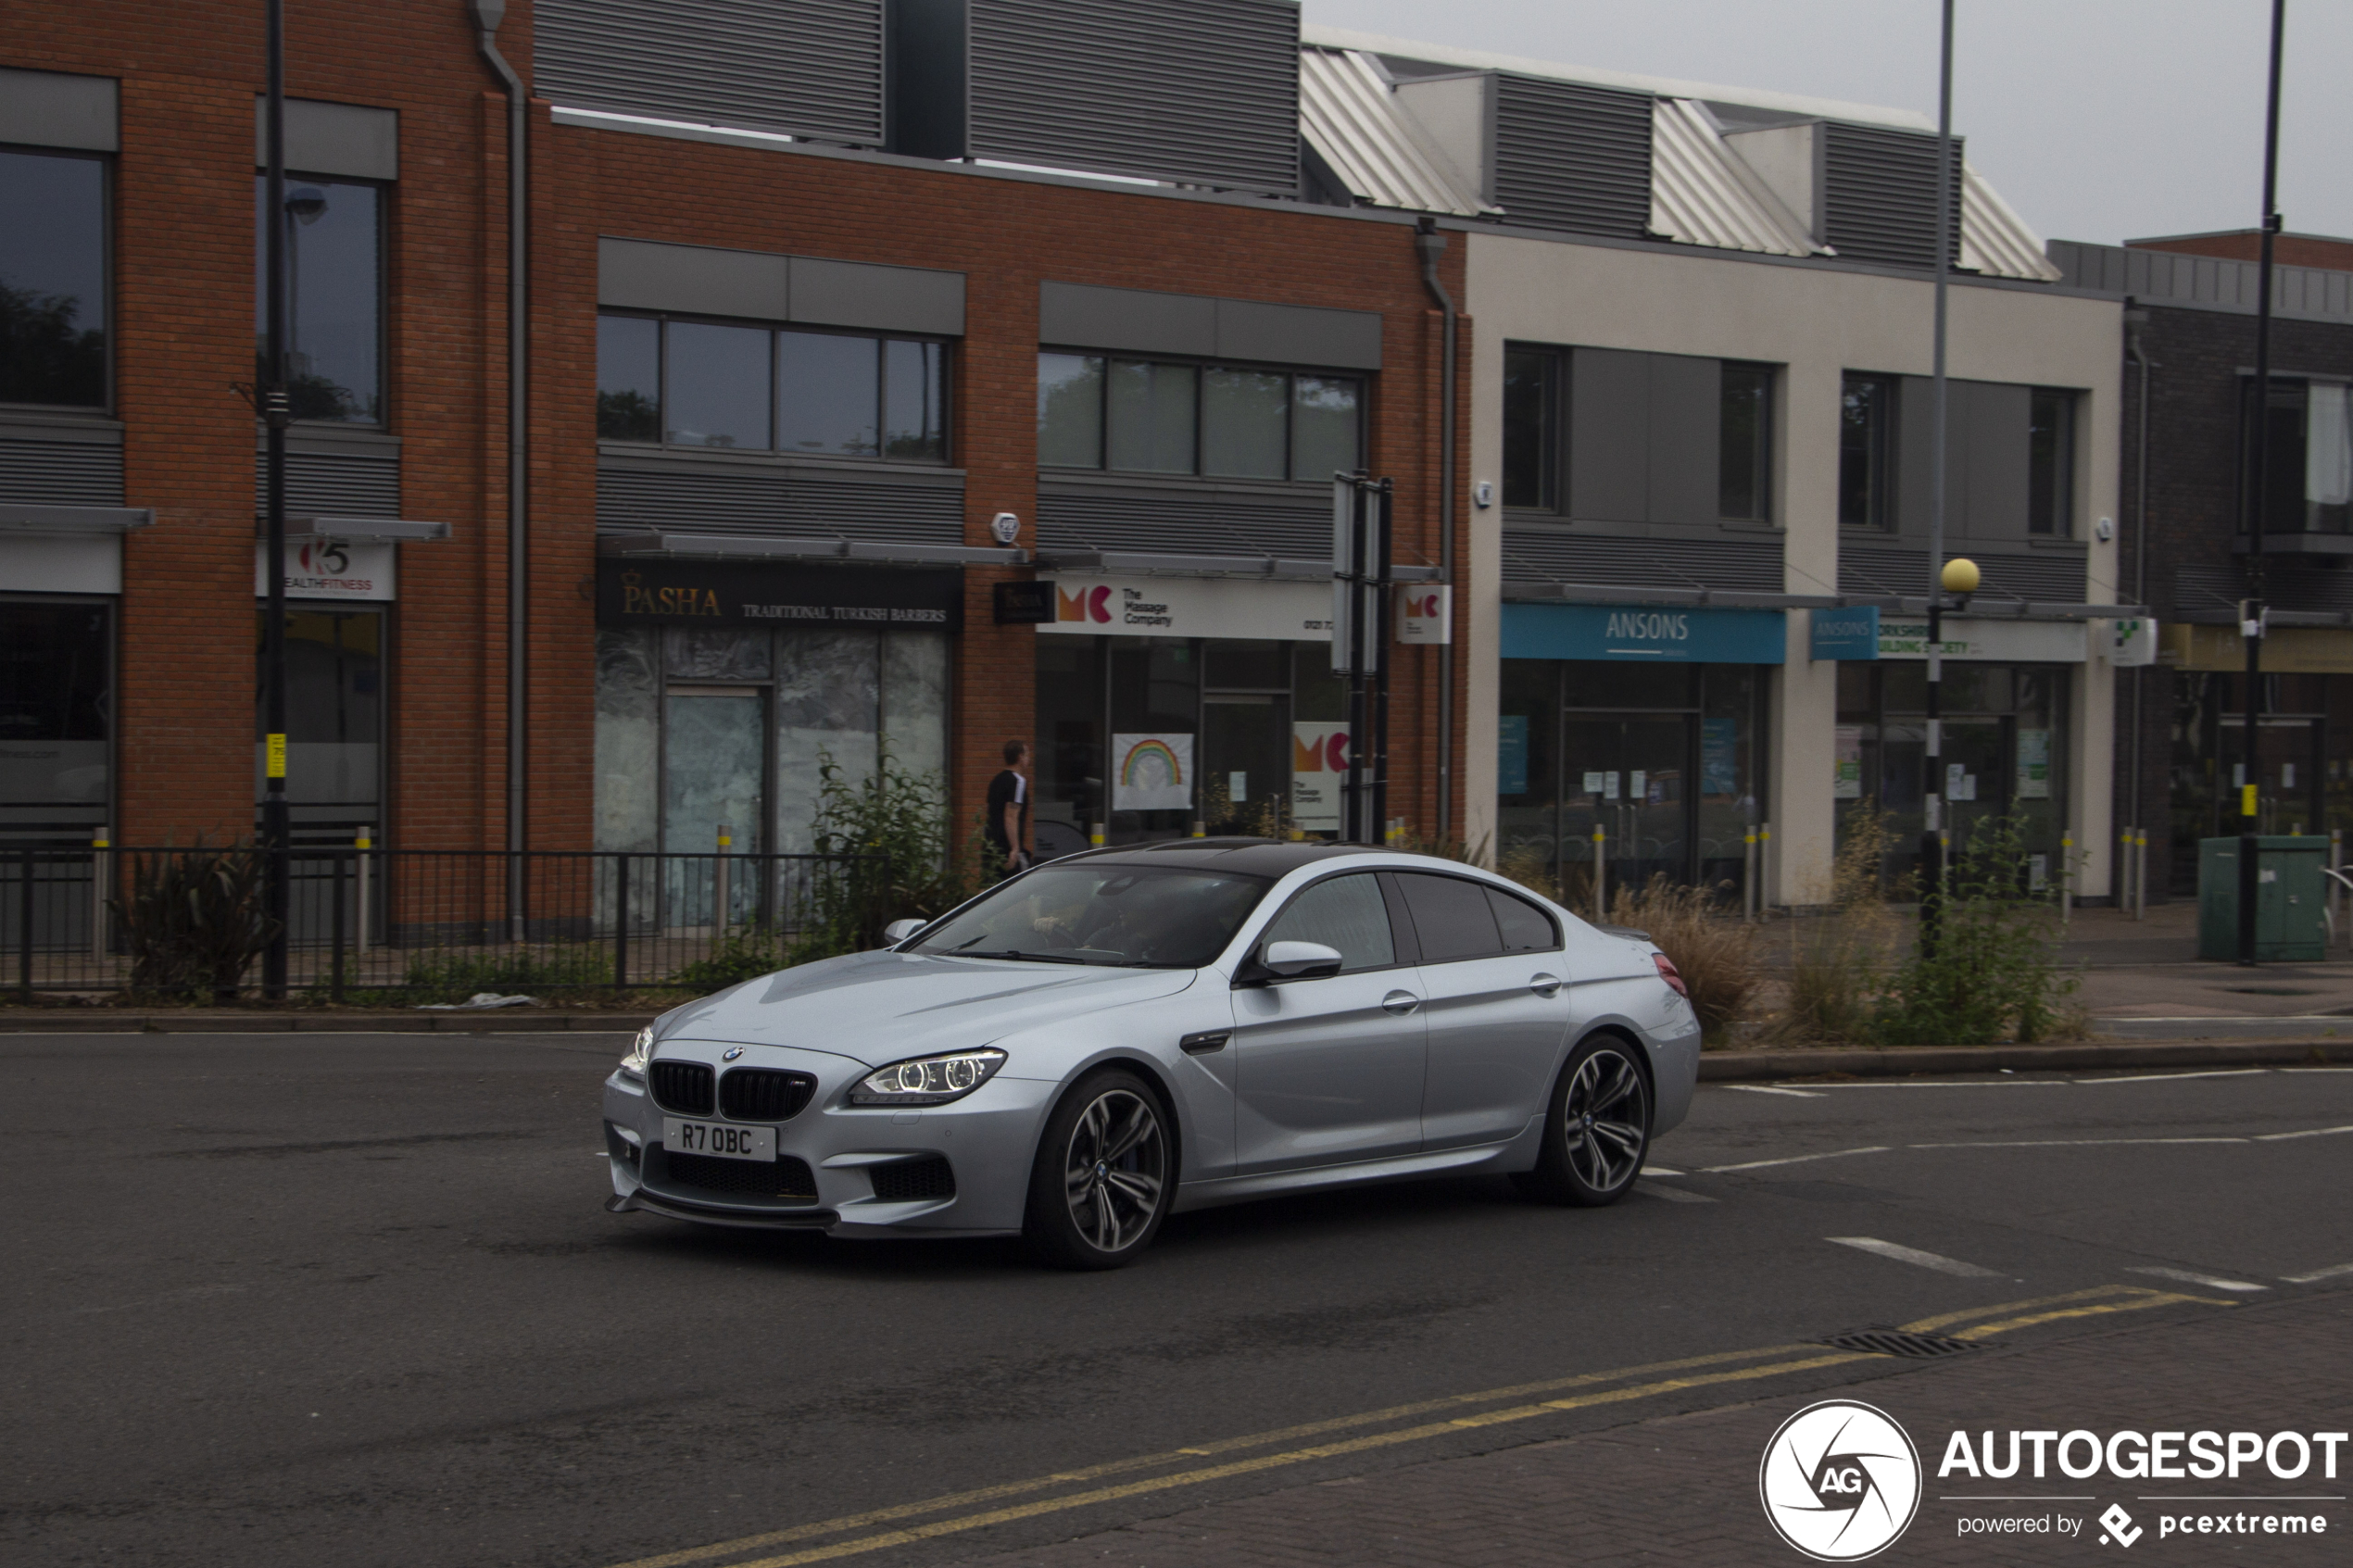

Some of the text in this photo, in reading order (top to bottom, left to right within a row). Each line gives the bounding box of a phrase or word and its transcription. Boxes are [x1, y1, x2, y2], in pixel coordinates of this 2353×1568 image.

[284, 577, 372, 590] EALTHFITNESS
[622, 585, 722, 617] PASHA
[1123, 588, 1141, 600] The
[742, 604, 947, 622] TRADITIONAL TURKISH BARBERS
[1125, 602, 1166, 614] Massage
[1125, 613, 1172, 626] Company
[1605, 613, 1689, 640] ANSONS
[1879, 640, 1922, 653] UILDING
[1923, 640, 1968, 654] SCIETY
[683, 1123, 751, 1155] R7 OBC
